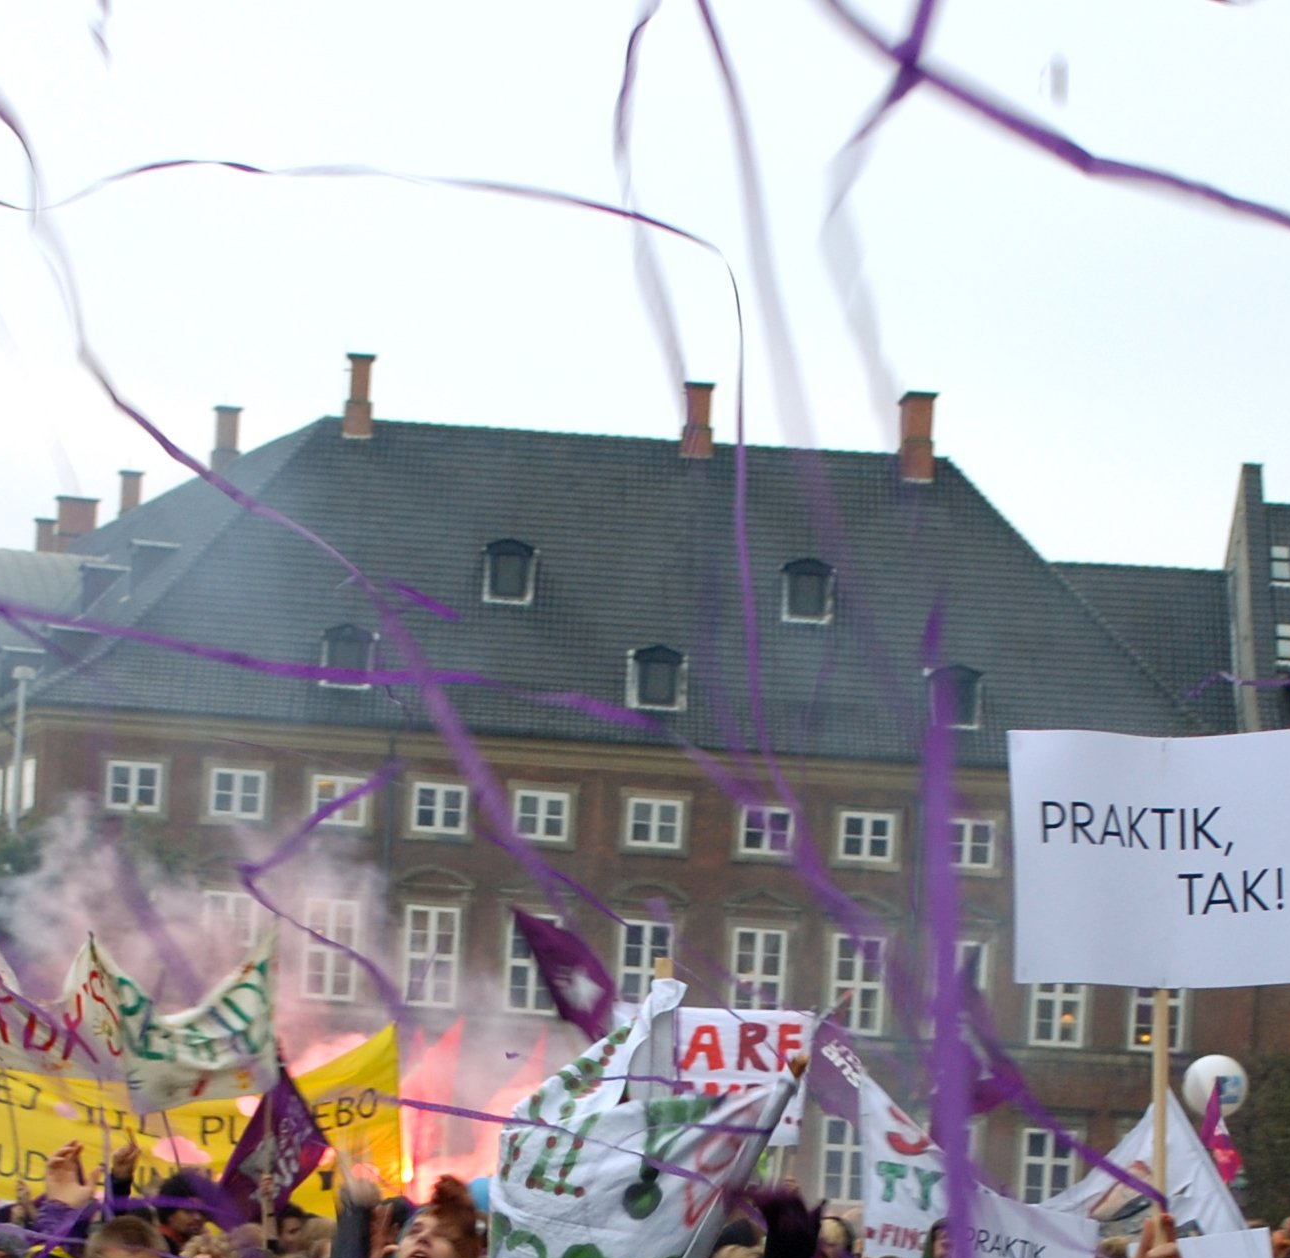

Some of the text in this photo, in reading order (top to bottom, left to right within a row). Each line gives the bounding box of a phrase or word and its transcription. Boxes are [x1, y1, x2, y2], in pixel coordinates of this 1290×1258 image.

[1040, 800, 1235, 857] PRAKTIK,
[1178, 867, 1286, 916] TAK!
[201, 1087, 378, 1146] PLEBO
